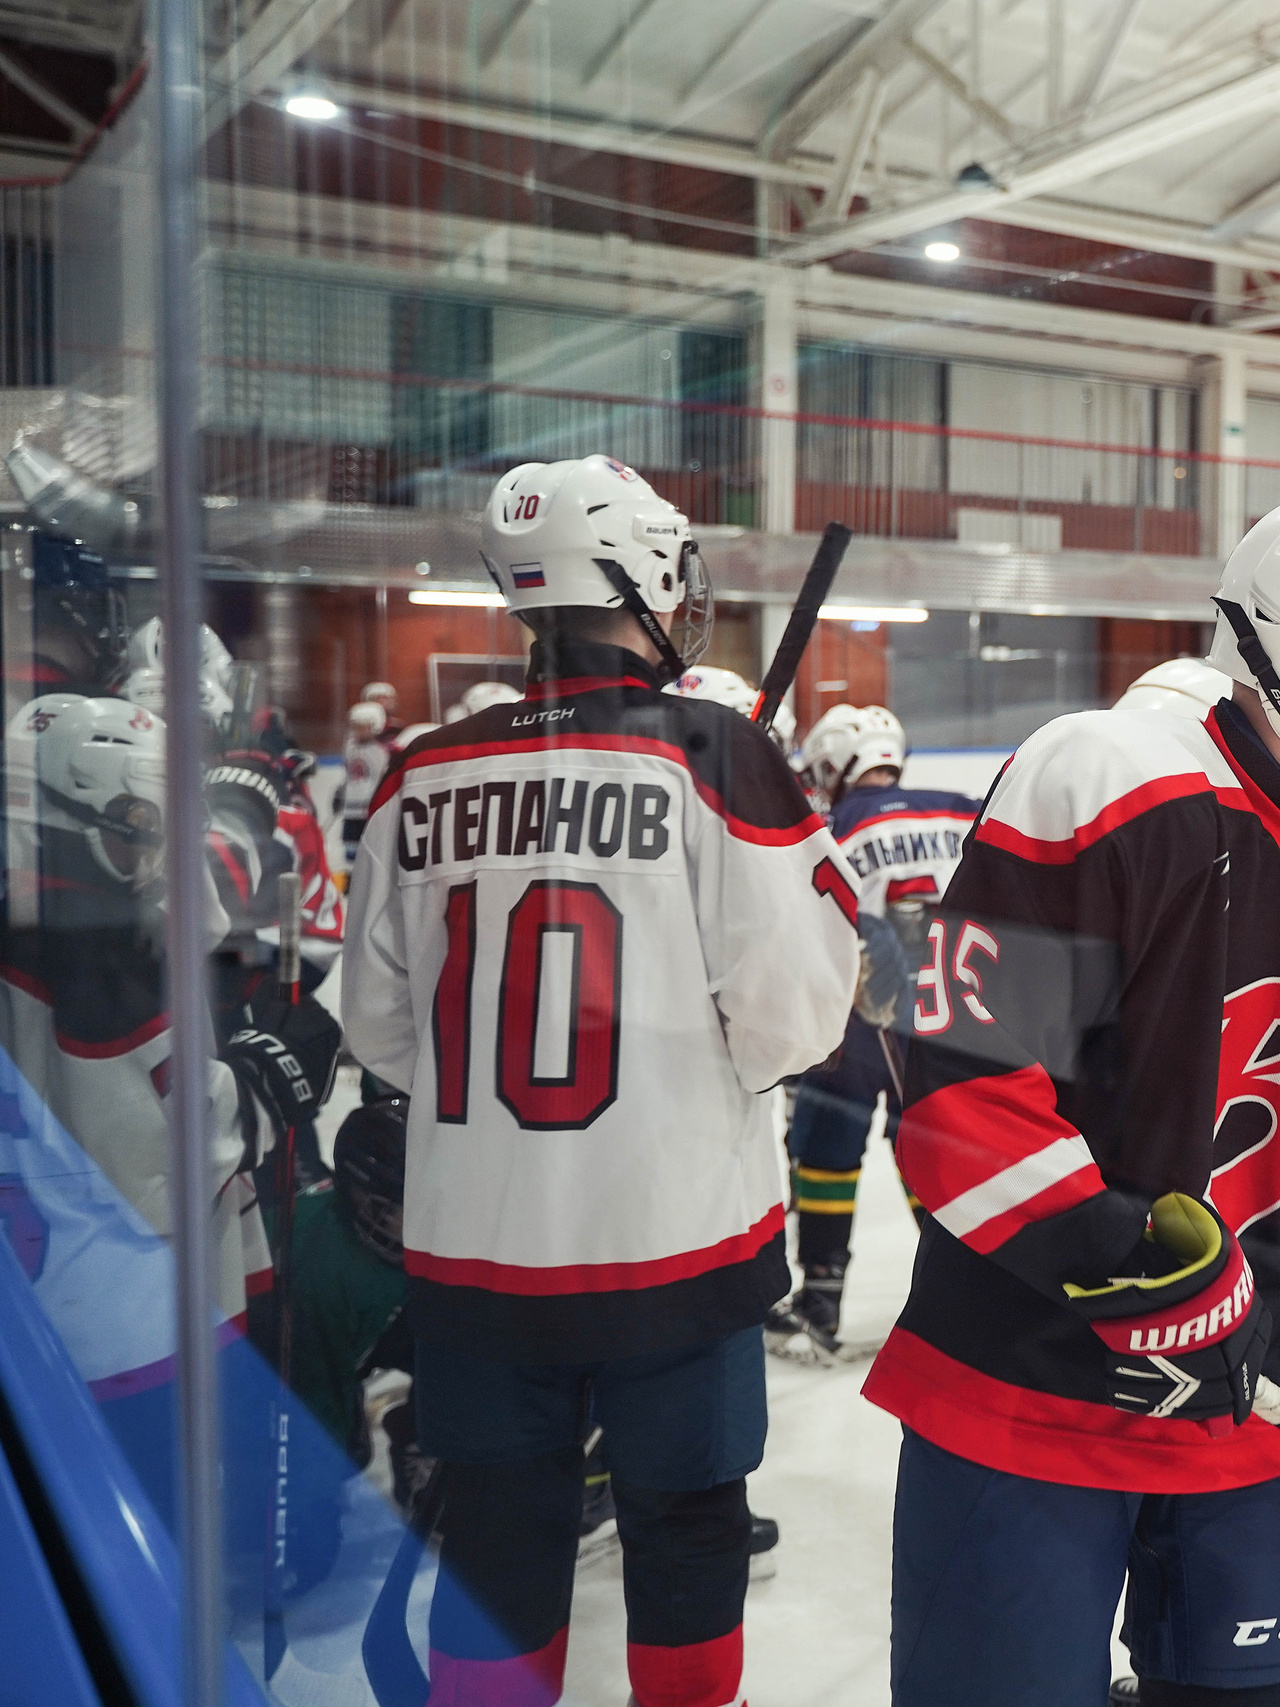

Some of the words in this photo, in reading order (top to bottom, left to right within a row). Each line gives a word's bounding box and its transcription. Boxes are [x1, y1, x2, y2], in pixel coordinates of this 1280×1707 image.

[513, 493, 540, 520] 10
[510, 707, 577, 728] LUTCH
[398, 777, 670, 872] СТЕПАНОВ
[432, 878, 624, 1132] 10
